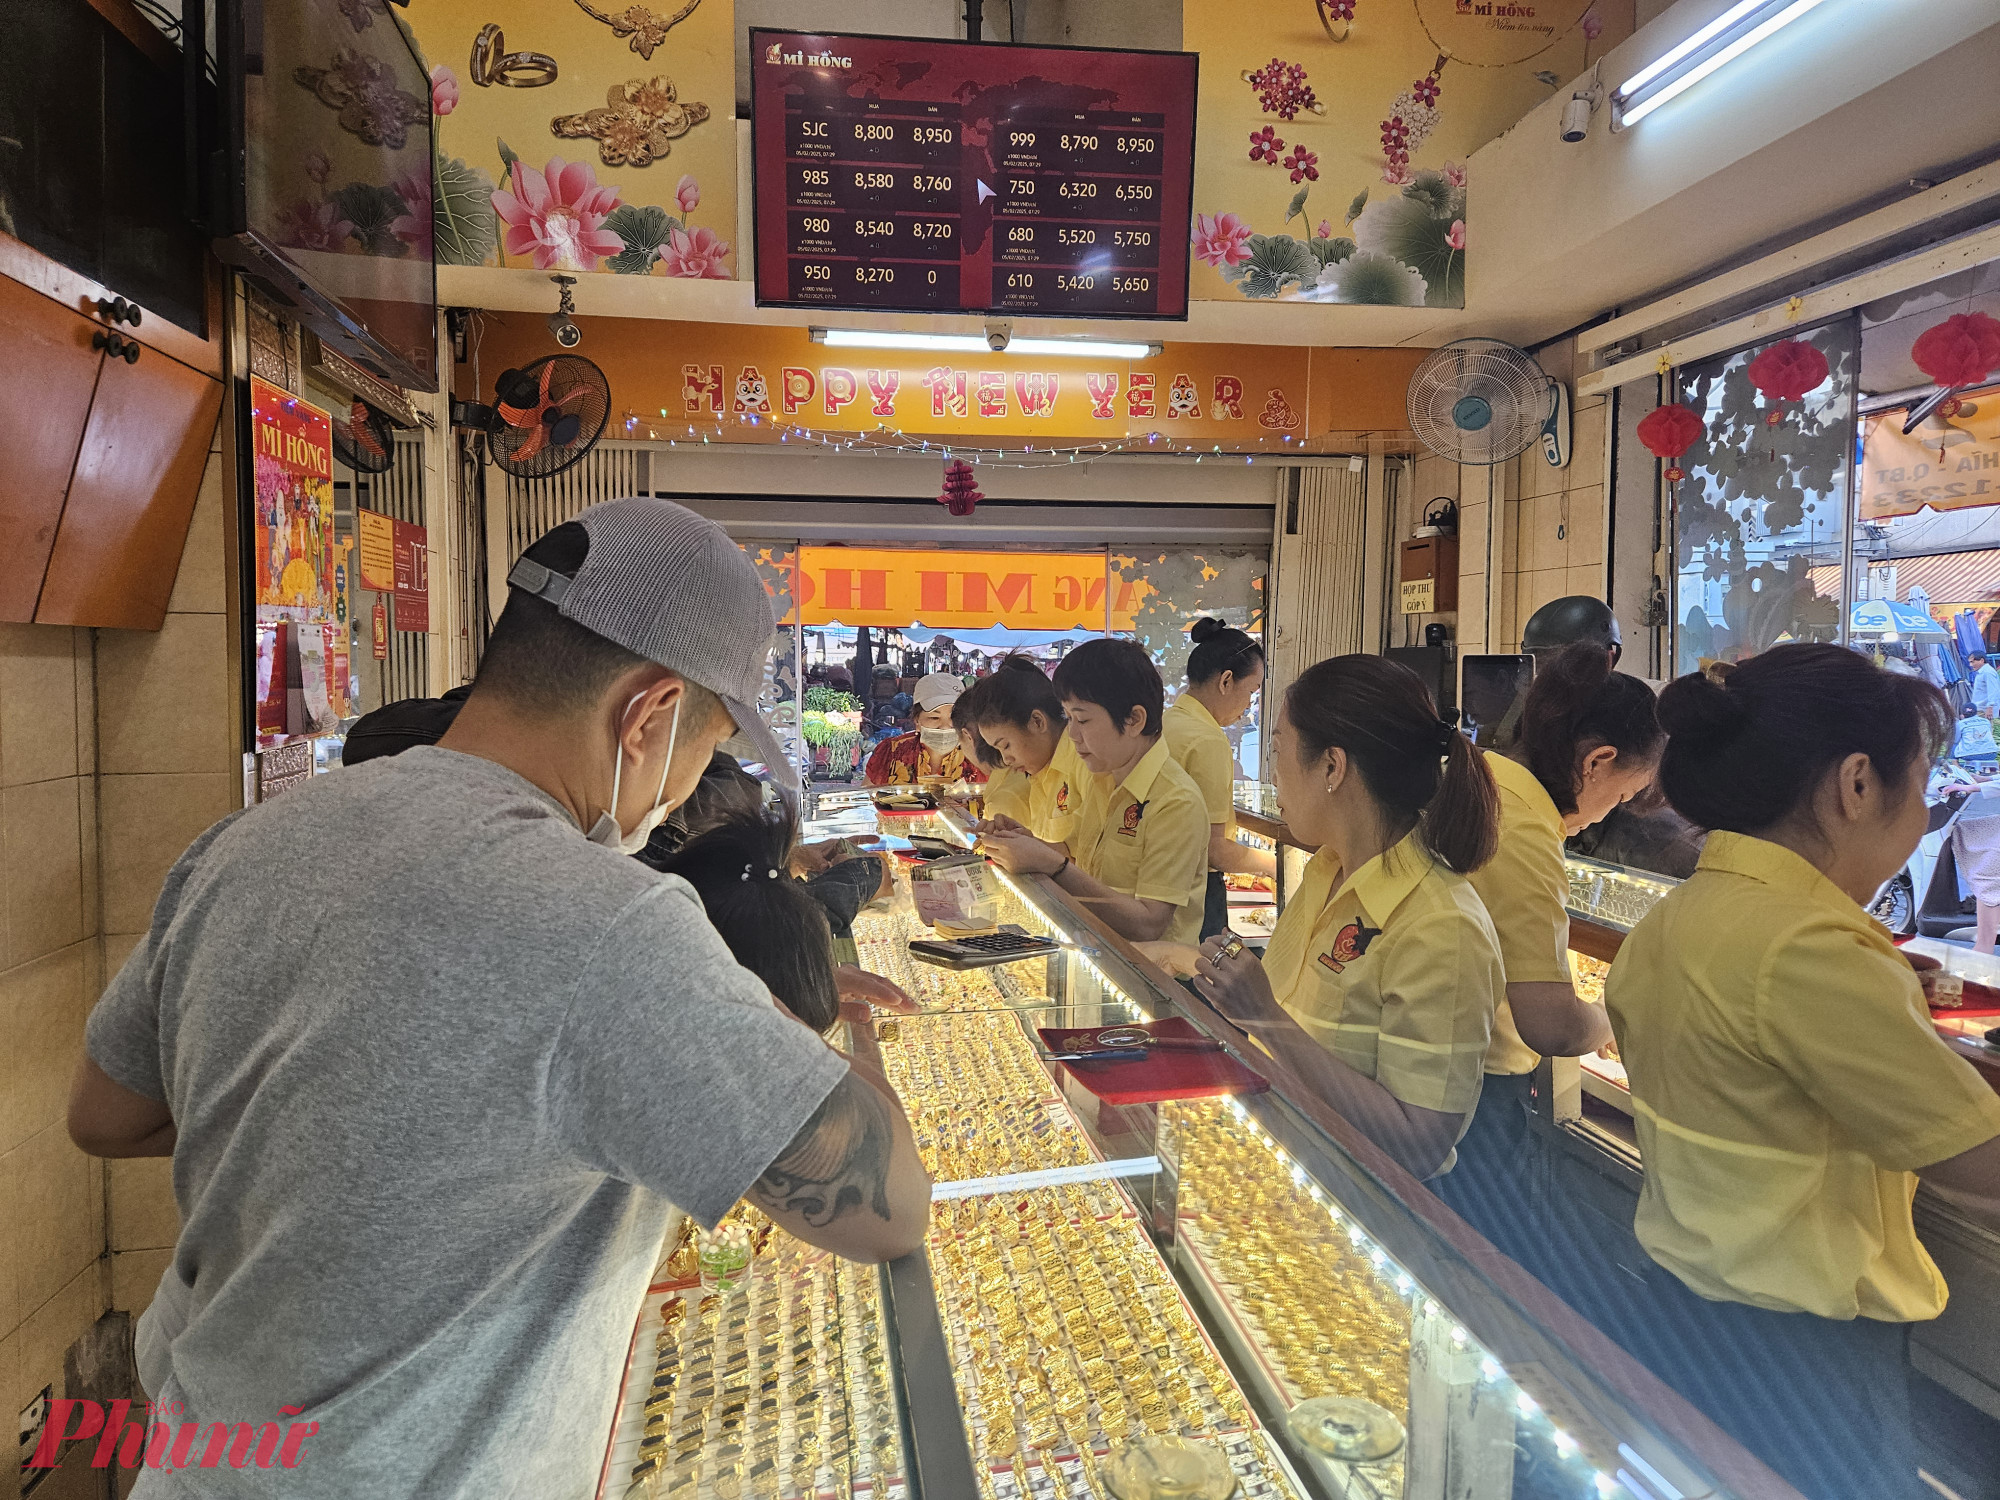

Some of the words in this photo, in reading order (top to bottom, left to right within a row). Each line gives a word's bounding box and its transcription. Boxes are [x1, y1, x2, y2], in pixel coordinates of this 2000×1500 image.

[802, 122, 828, 137] SJC
[854, 124, 894, 142] 8,800
[913, 128, 952, 144] 8,950
[1010, 132, 1036, 147] 999
[1060, 134, 1098, 152] 8,790
[1116, 138, 1154, 154] 8,950
[802, 170, 829, 185] 985
[854, 172, 894, 190] 8,580
[913, 175, 952, 192] 8,760
[1010, 180, 1035, 194] 750
[1059, 182, 1097, 199] 6,320
[1116, 185, 1152, 201] 6,550
[803, 218, 830, 232] 980
[855, 220, 894, 237] 8,540
[913, 223, 952, 240] 8,720
[1008, 227, 1034, 242] 680
[1058, 230, 1096, 246] 5,520
[1114, 232, 1150, 248] 5,750
[804, 266, 831, 280] 950
[856, 268, 894, 284] 8,270
[927, 270, 936, 284] 0
[1008, 273, 1033, 288] 610
[1058, 275, 1094, 291] 5,420
[1112, 278, 1149, 293] 5,650
[682, 364, 900, 417] HAPPY
[922, 366, 1060, 418] NEW
[1086, 372, 1245, 420] YEAR
[1854, 611, 1887, 626] be
[1893, 612, 1928, 627] be
